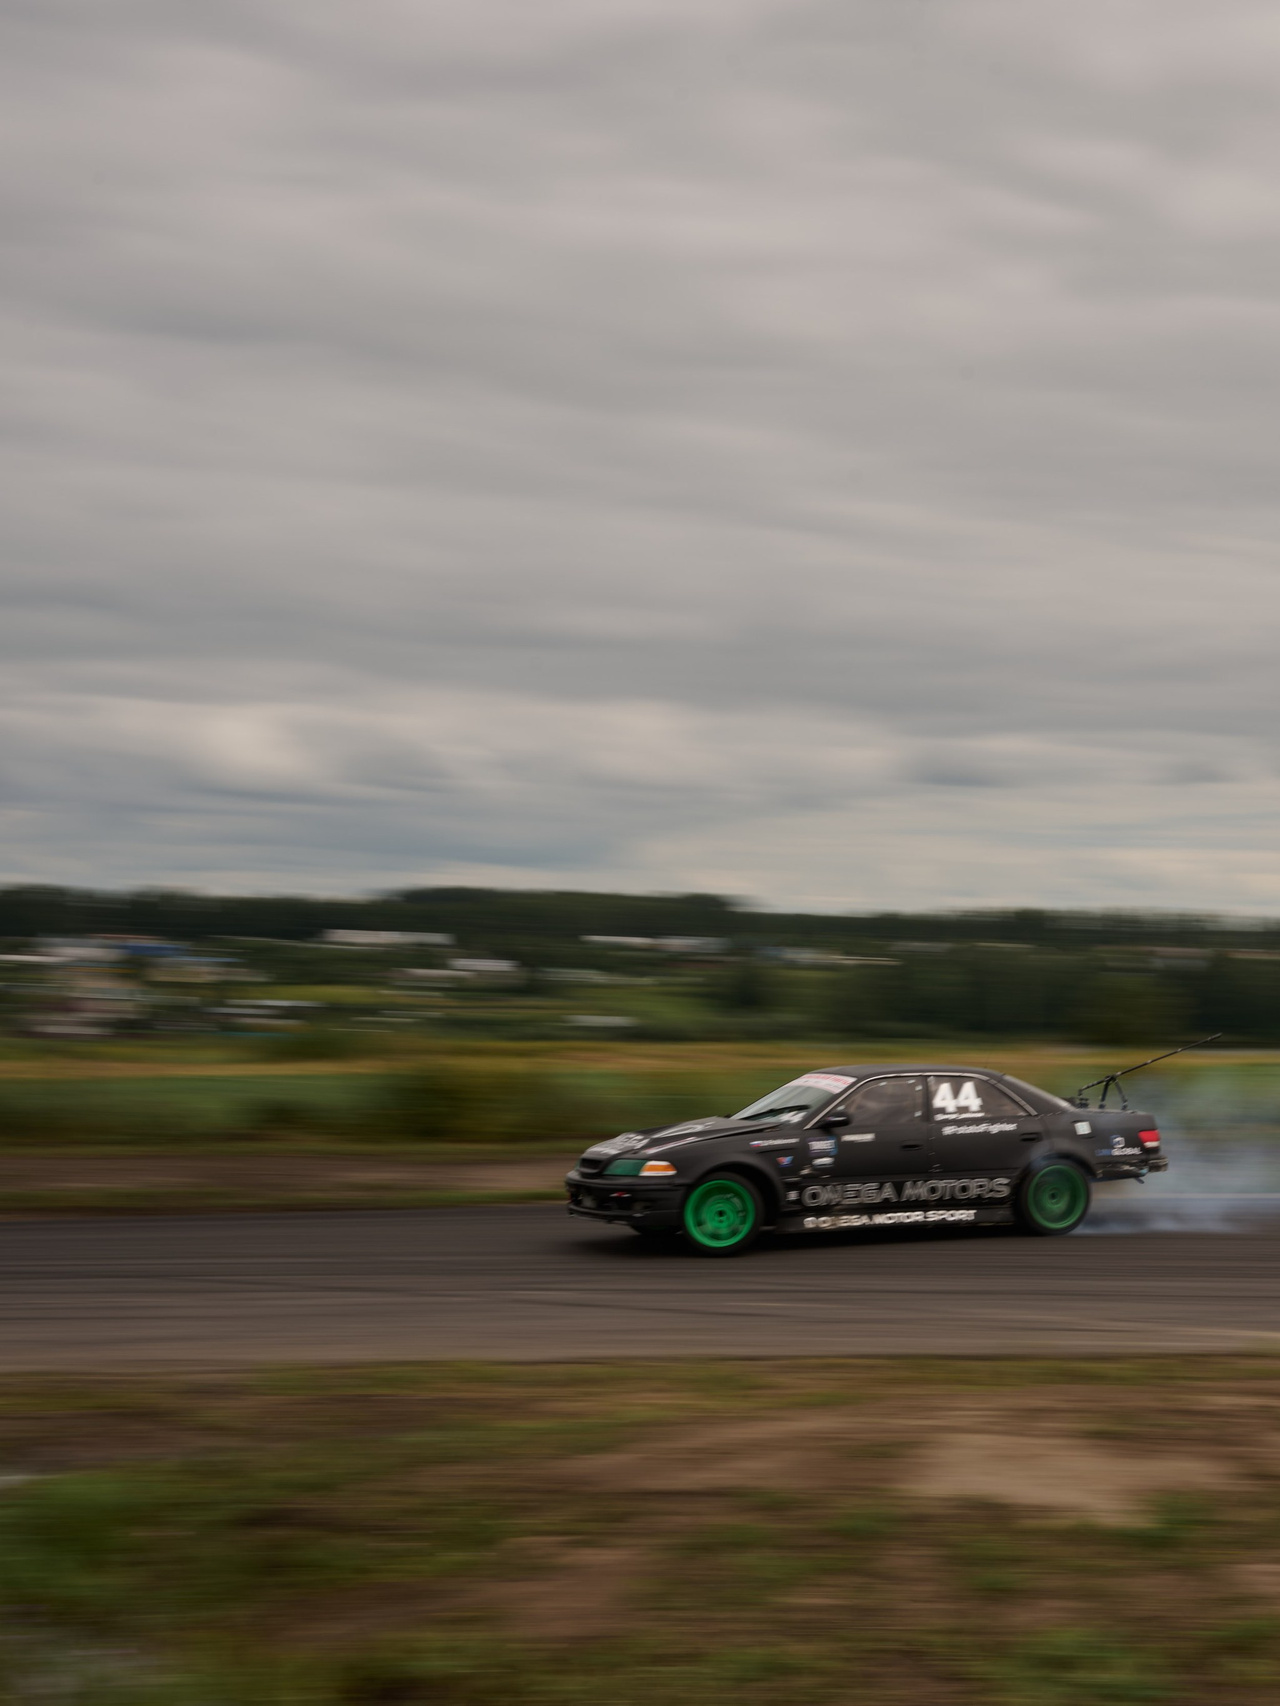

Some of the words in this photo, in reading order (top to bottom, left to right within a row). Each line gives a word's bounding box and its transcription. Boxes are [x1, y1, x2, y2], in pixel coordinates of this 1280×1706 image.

[932, 1081, 983, 1113] 44
[802, 1181, 899, 1207] OMEGA
[901, 1178, 1011, 1201] MOTORS
